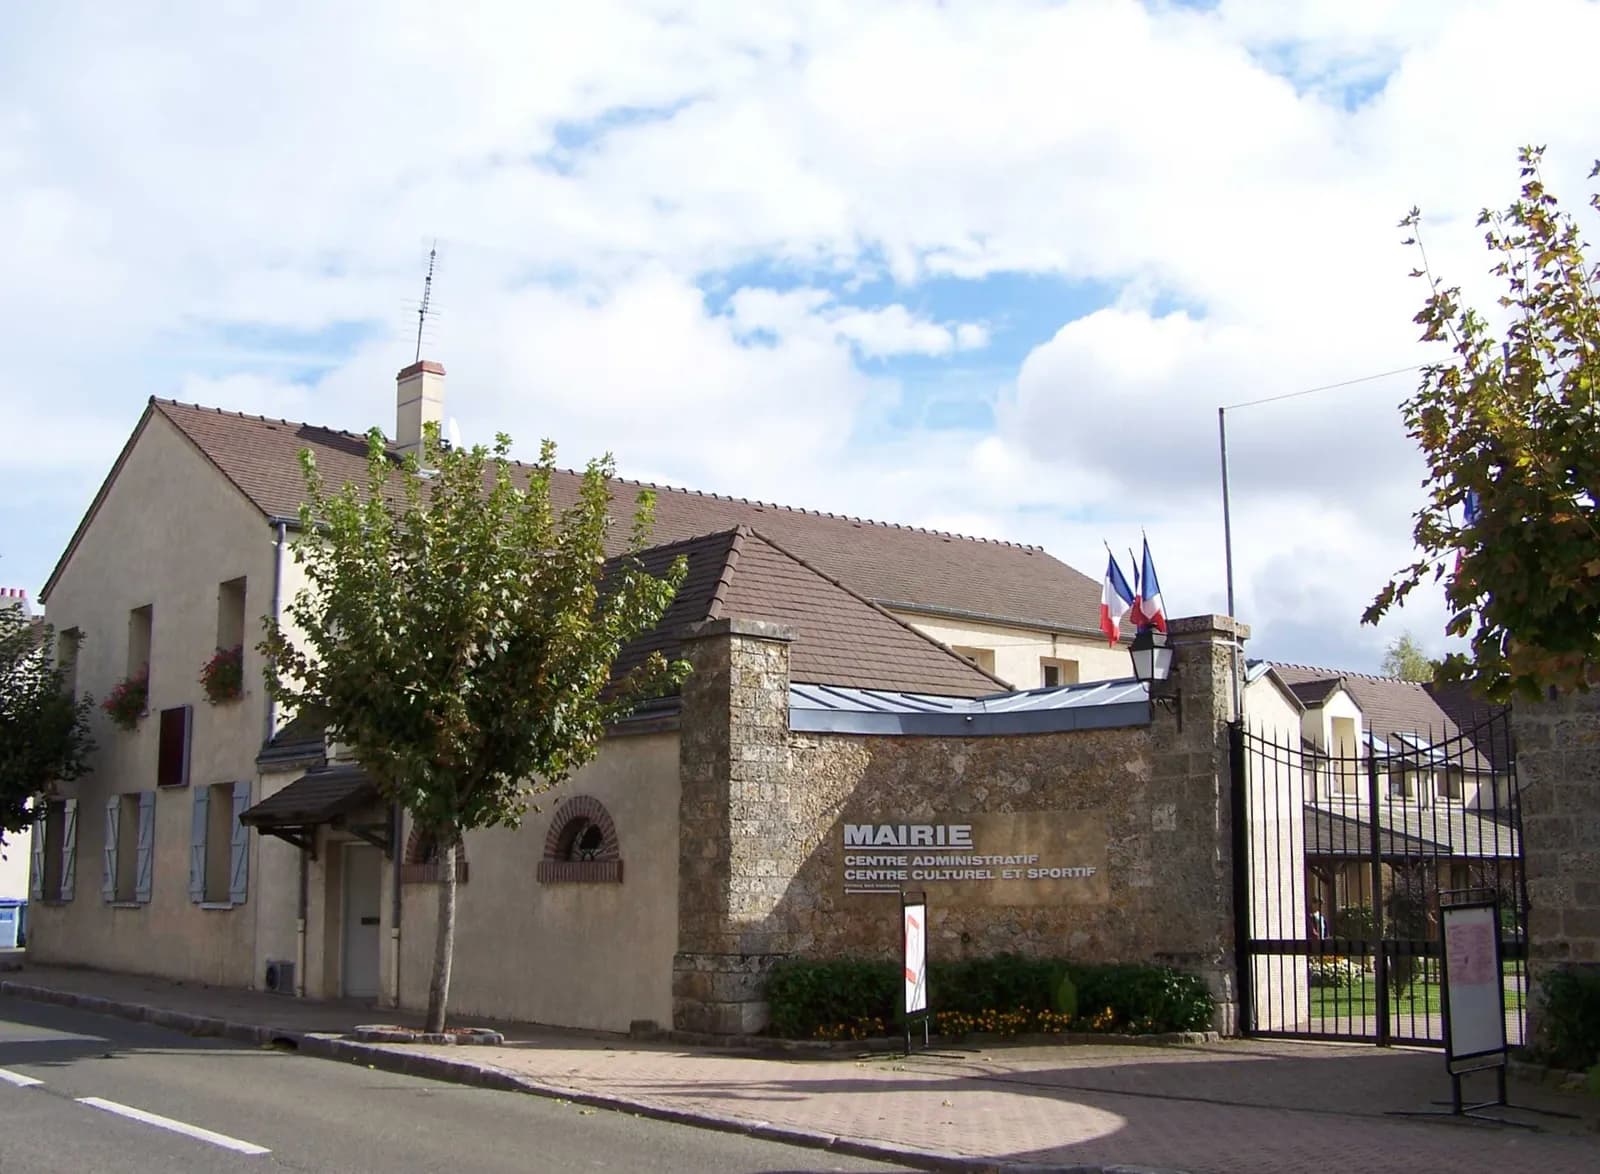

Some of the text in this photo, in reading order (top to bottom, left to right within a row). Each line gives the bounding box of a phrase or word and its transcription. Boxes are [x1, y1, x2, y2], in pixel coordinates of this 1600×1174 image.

[844, 824, 973, 846] MAIRIE
[844, 854, 1039, 866] CENTRE ADMINISTRATIF
[844, 867, 1097, 881] CENTRE CULTUREL ET SPORTIF
